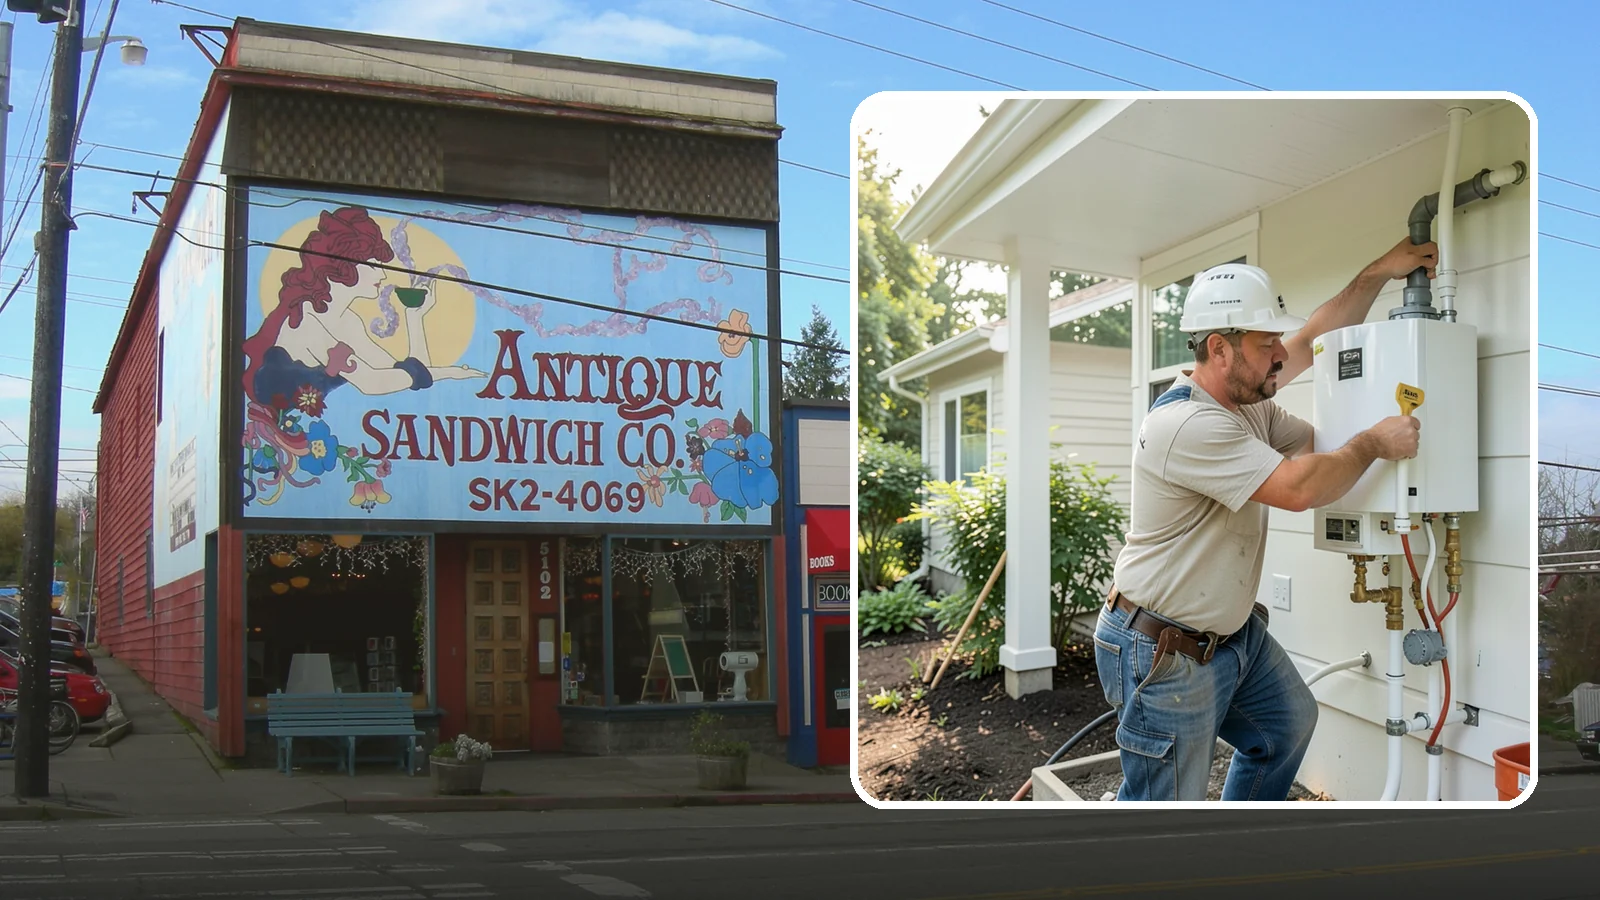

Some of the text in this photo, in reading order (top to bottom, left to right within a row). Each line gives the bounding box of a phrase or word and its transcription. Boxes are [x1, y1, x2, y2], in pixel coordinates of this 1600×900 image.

[476, 329, 723, 420] ANTIQUE
[361, 409, 685, 468] SANDWICH CO.
[468, 477, 645, 512] SK2-4069
[540, 542, 551, 599] 5102
[809, 555, 835, 569] BOOKS
